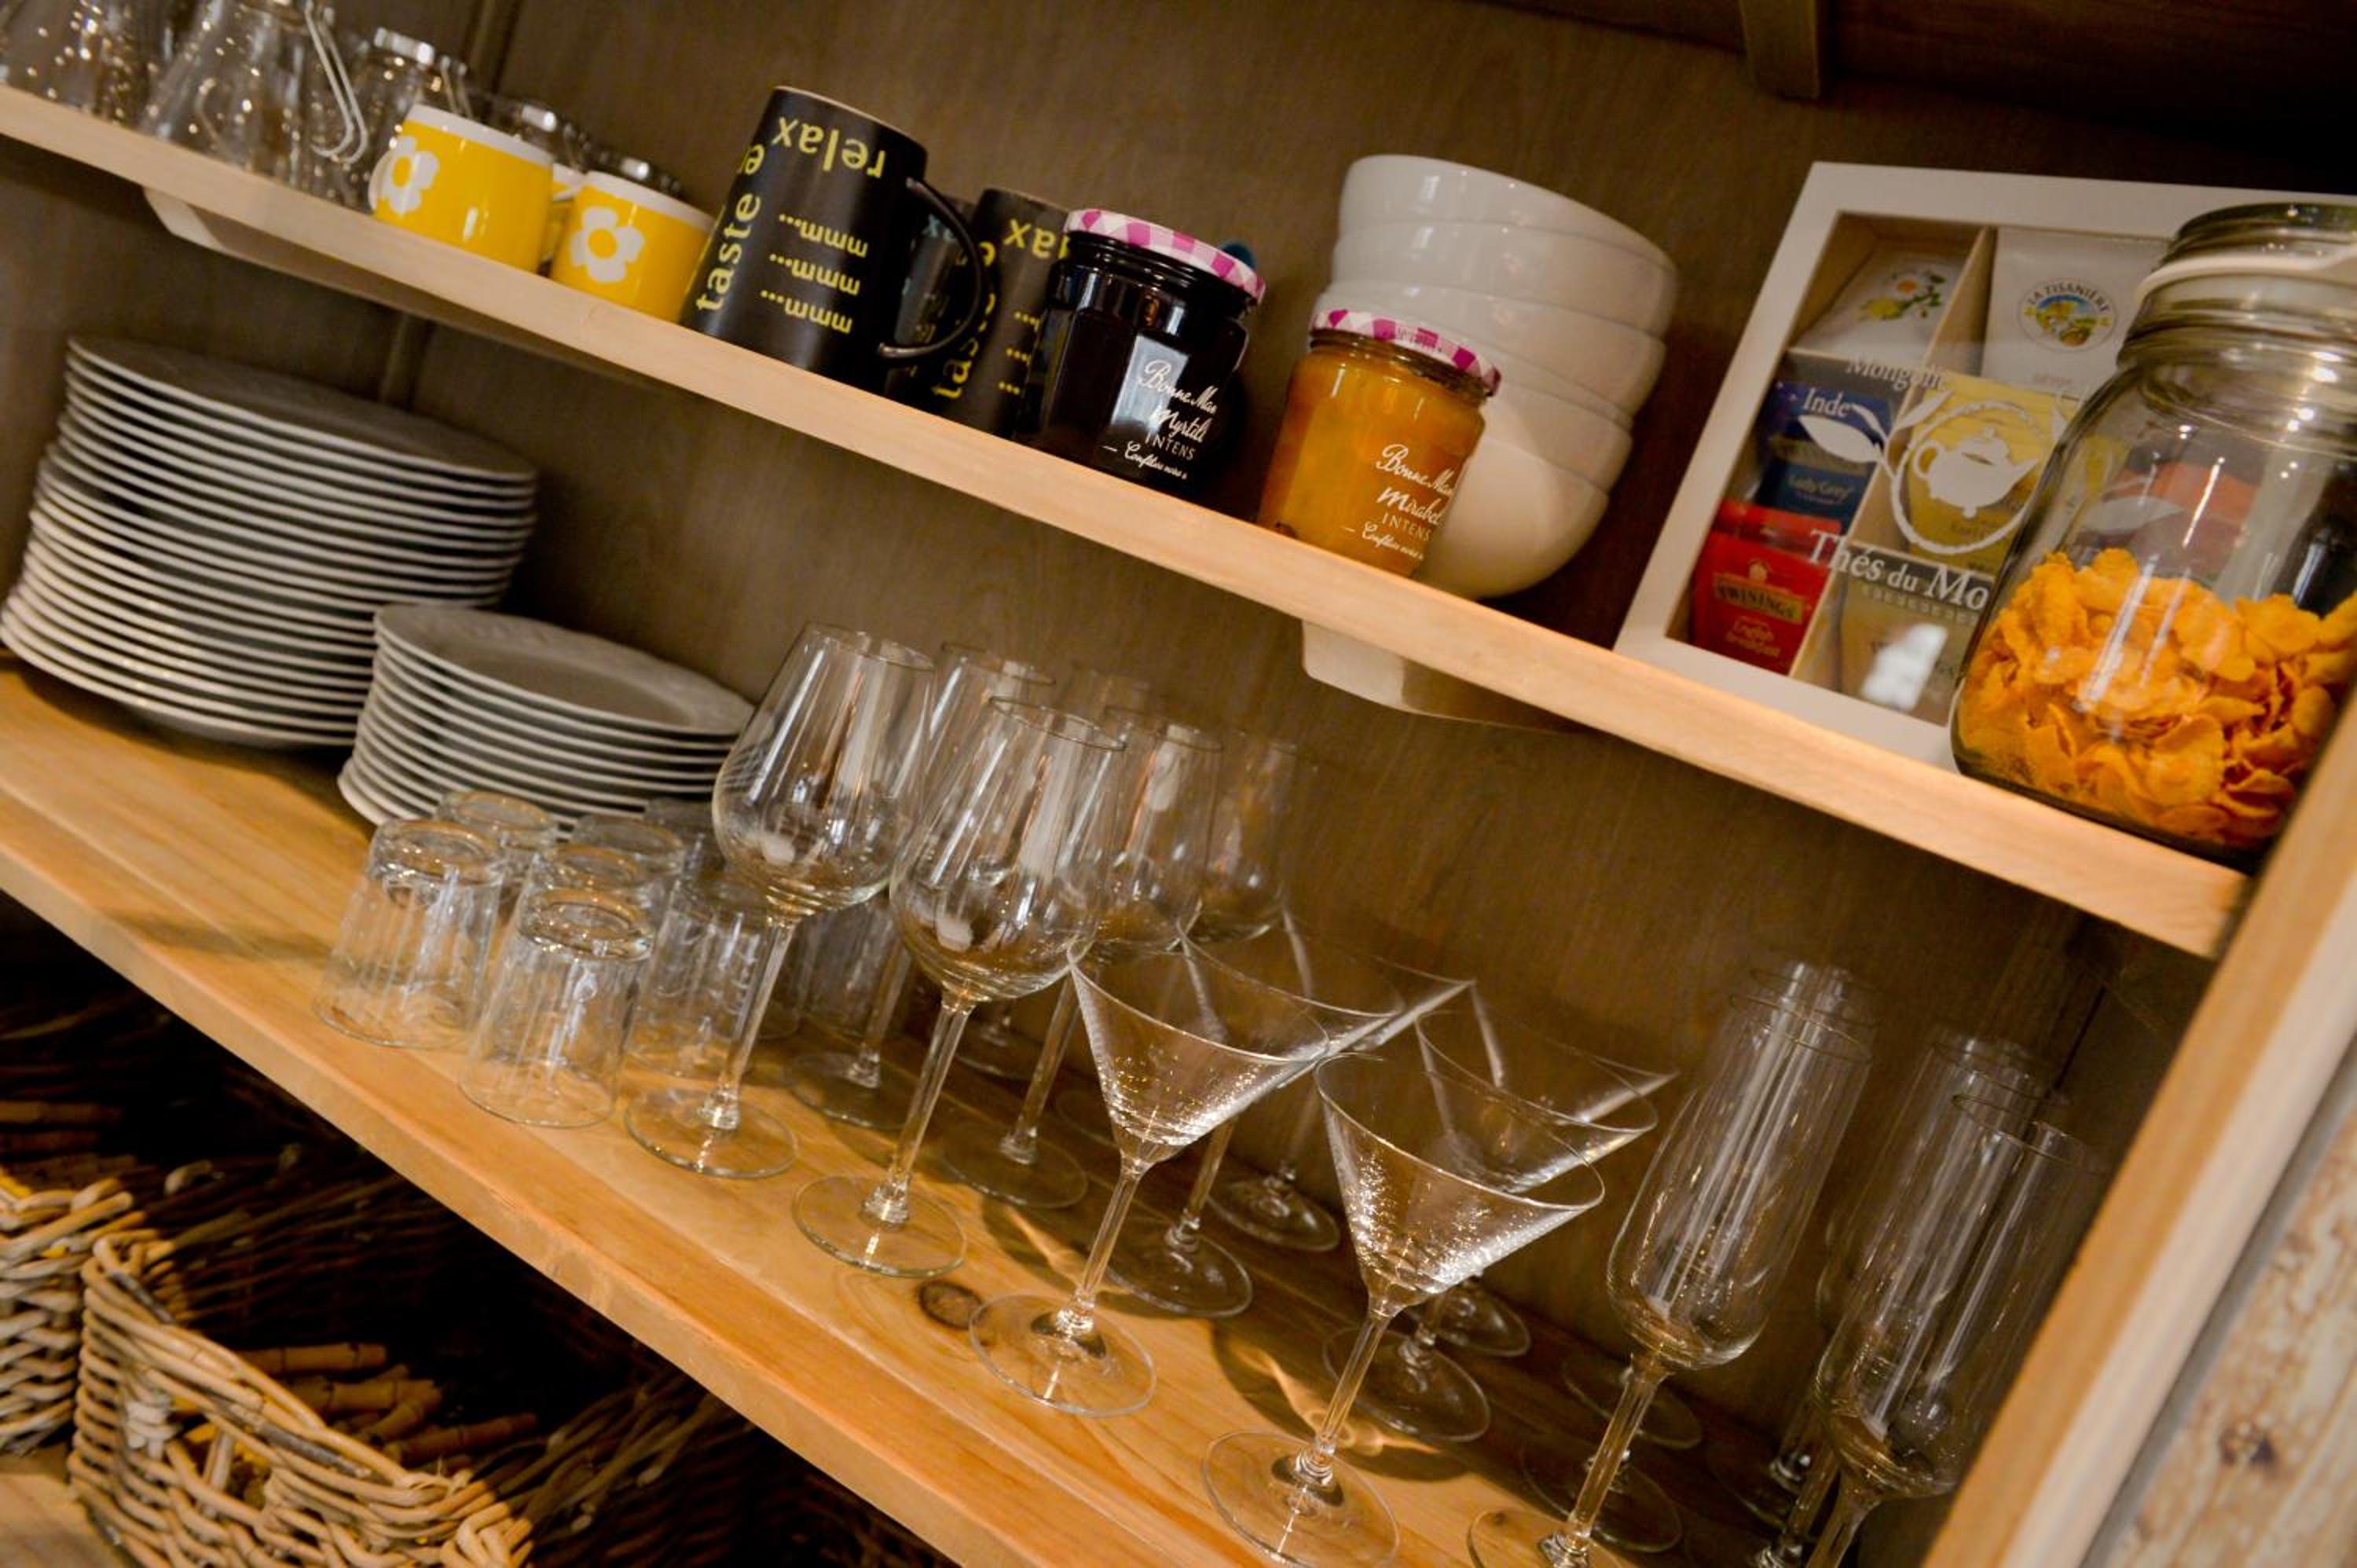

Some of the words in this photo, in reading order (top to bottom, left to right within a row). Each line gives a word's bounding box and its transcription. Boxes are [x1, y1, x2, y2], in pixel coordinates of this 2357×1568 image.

[772, 116, 886, 178] relax
[695, 192, 761, 312] taste
[1003, 218, 1071, 260] lax
[1802, 387, 1852, 417] Inde
[1809, 529, 1886, 581] Thés
[1887, 562, 1919, 592] du
[1924, 564, 1990, 610] Mo
